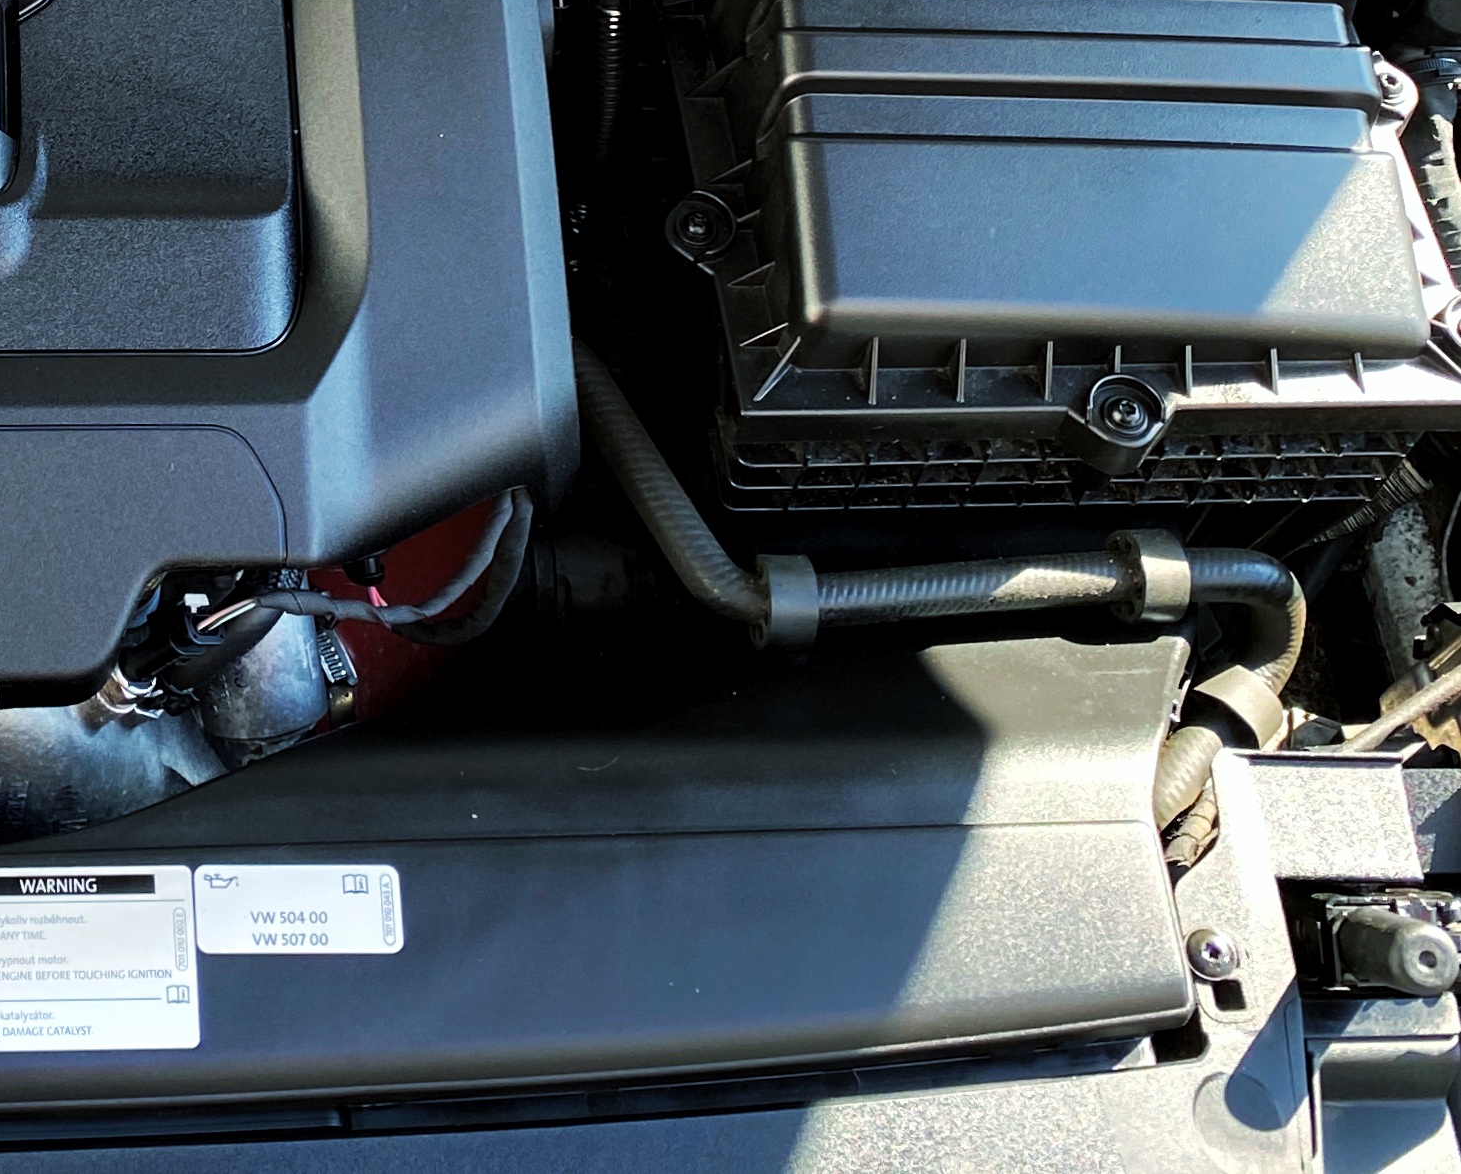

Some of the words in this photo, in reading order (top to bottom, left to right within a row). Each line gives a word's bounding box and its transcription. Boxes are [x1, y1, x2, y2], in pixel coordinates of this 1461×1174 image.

[19, 878, 98, 894] WARNING
[250, 911, 276, 924] VW
[280, 911, 305, 924] 504
[309, 911, 328, 924] 00
[0, 931, 20, 940] ANY
[252, 933, 278, 946] VW
[281, 933, 306, 946] 507
[309, 933, 328, 946] 00
[35, 971, 71, 981] BEFORE
[73, 970, 126, 980] TOUCHING
[128, 969, 172, 979] IGNITION
[2, 1026, 44, 1037] DAMAGE
